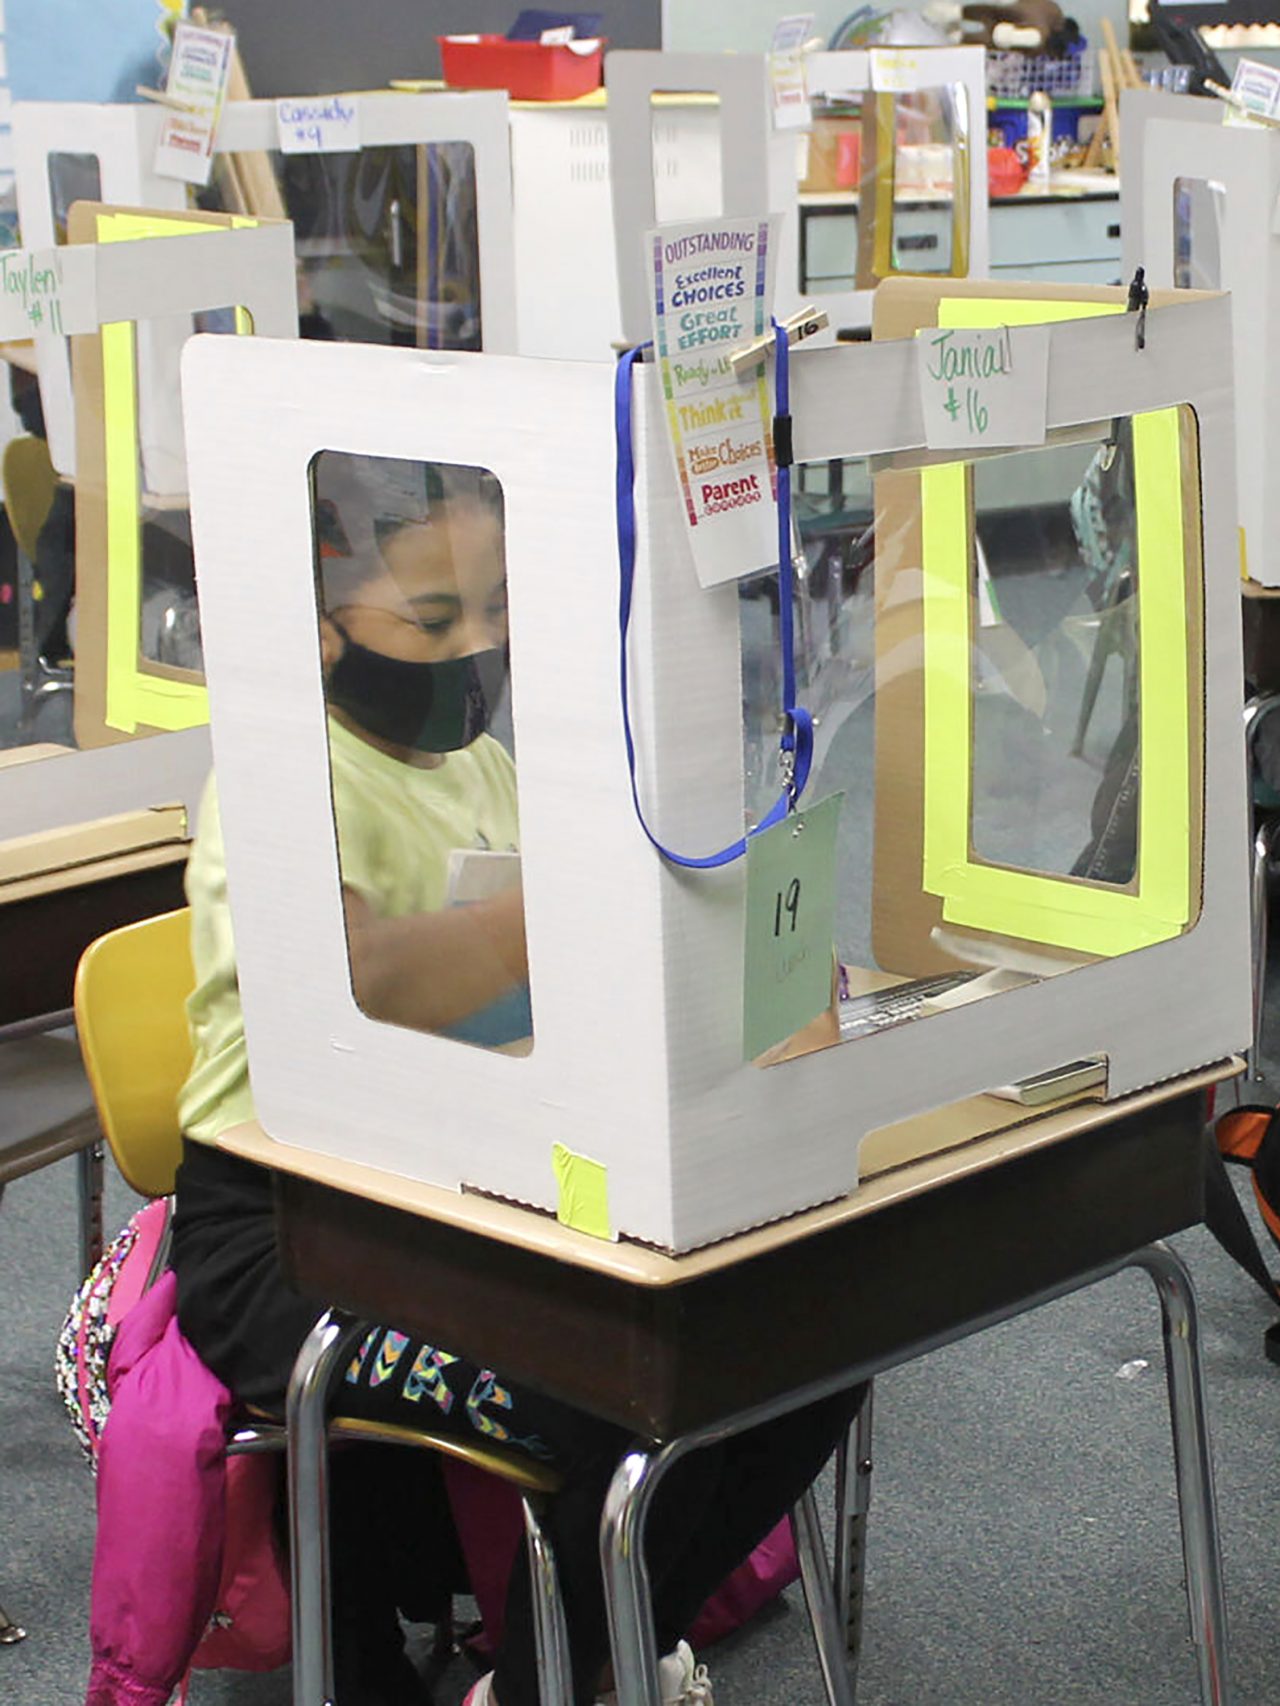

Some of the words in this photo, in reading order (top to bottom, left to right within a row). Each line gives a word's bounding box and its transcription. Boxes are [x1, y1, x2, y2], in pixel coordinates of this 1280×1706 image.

[665, 232, 755, 264] OUTSTANDING
[675, 266, 743, 290] Excellent
[671, 280, 745, 308] CHOICES
[680, 306, 738, 332] Great
[797, 321, 820, 341] 16
[677, 324, 743, 351] EFFORT
[679, 398, 726, 432] Think
[719, 437, 761, 465] Choices
[701, 474, 759, 505] Parent
[774, 877, 801, 937] 19
